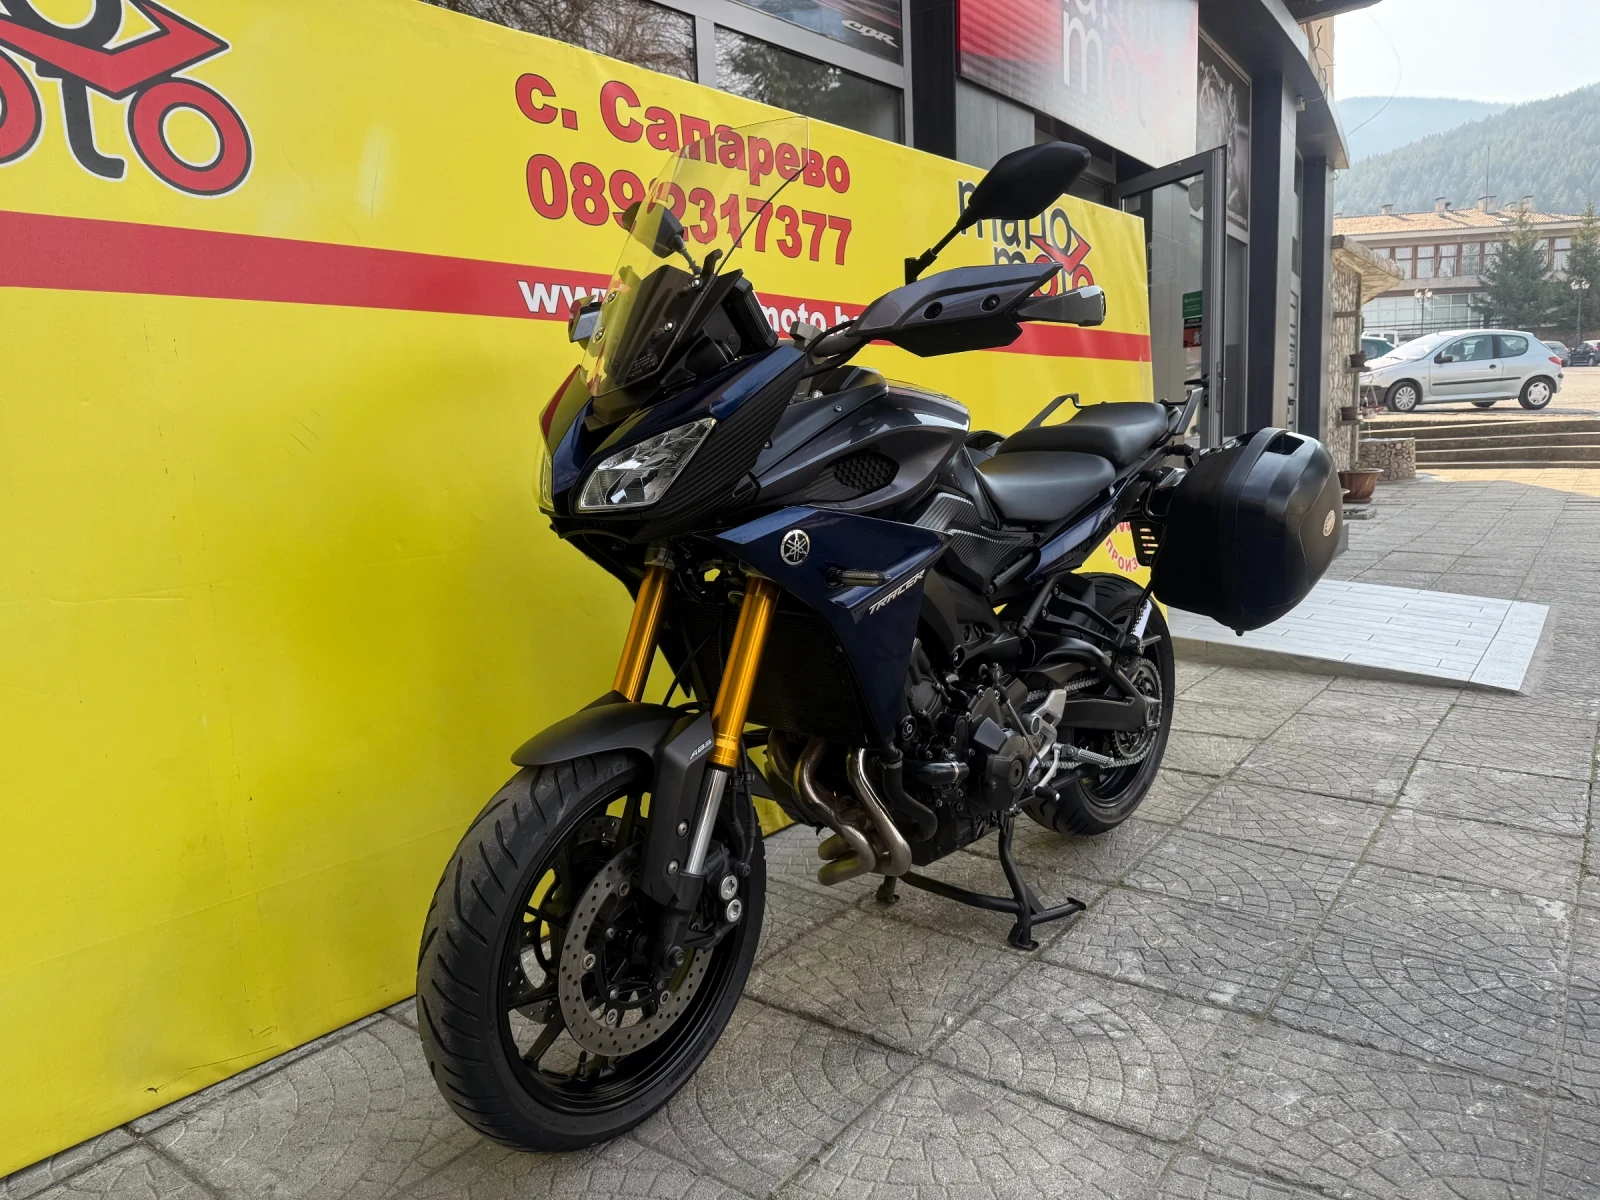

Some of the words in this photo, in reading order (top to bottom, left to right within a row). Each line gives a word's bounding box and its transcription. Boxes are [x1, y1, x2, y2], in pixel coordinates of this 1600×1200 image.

[515, 73, 579, 131] с.
[600, 80, 851, 194] Сапарево
[526, 153, 852, 266] 0892317377
[868, 568, 926, 615] TRACER
[689, 738, 712, 760] ABS
